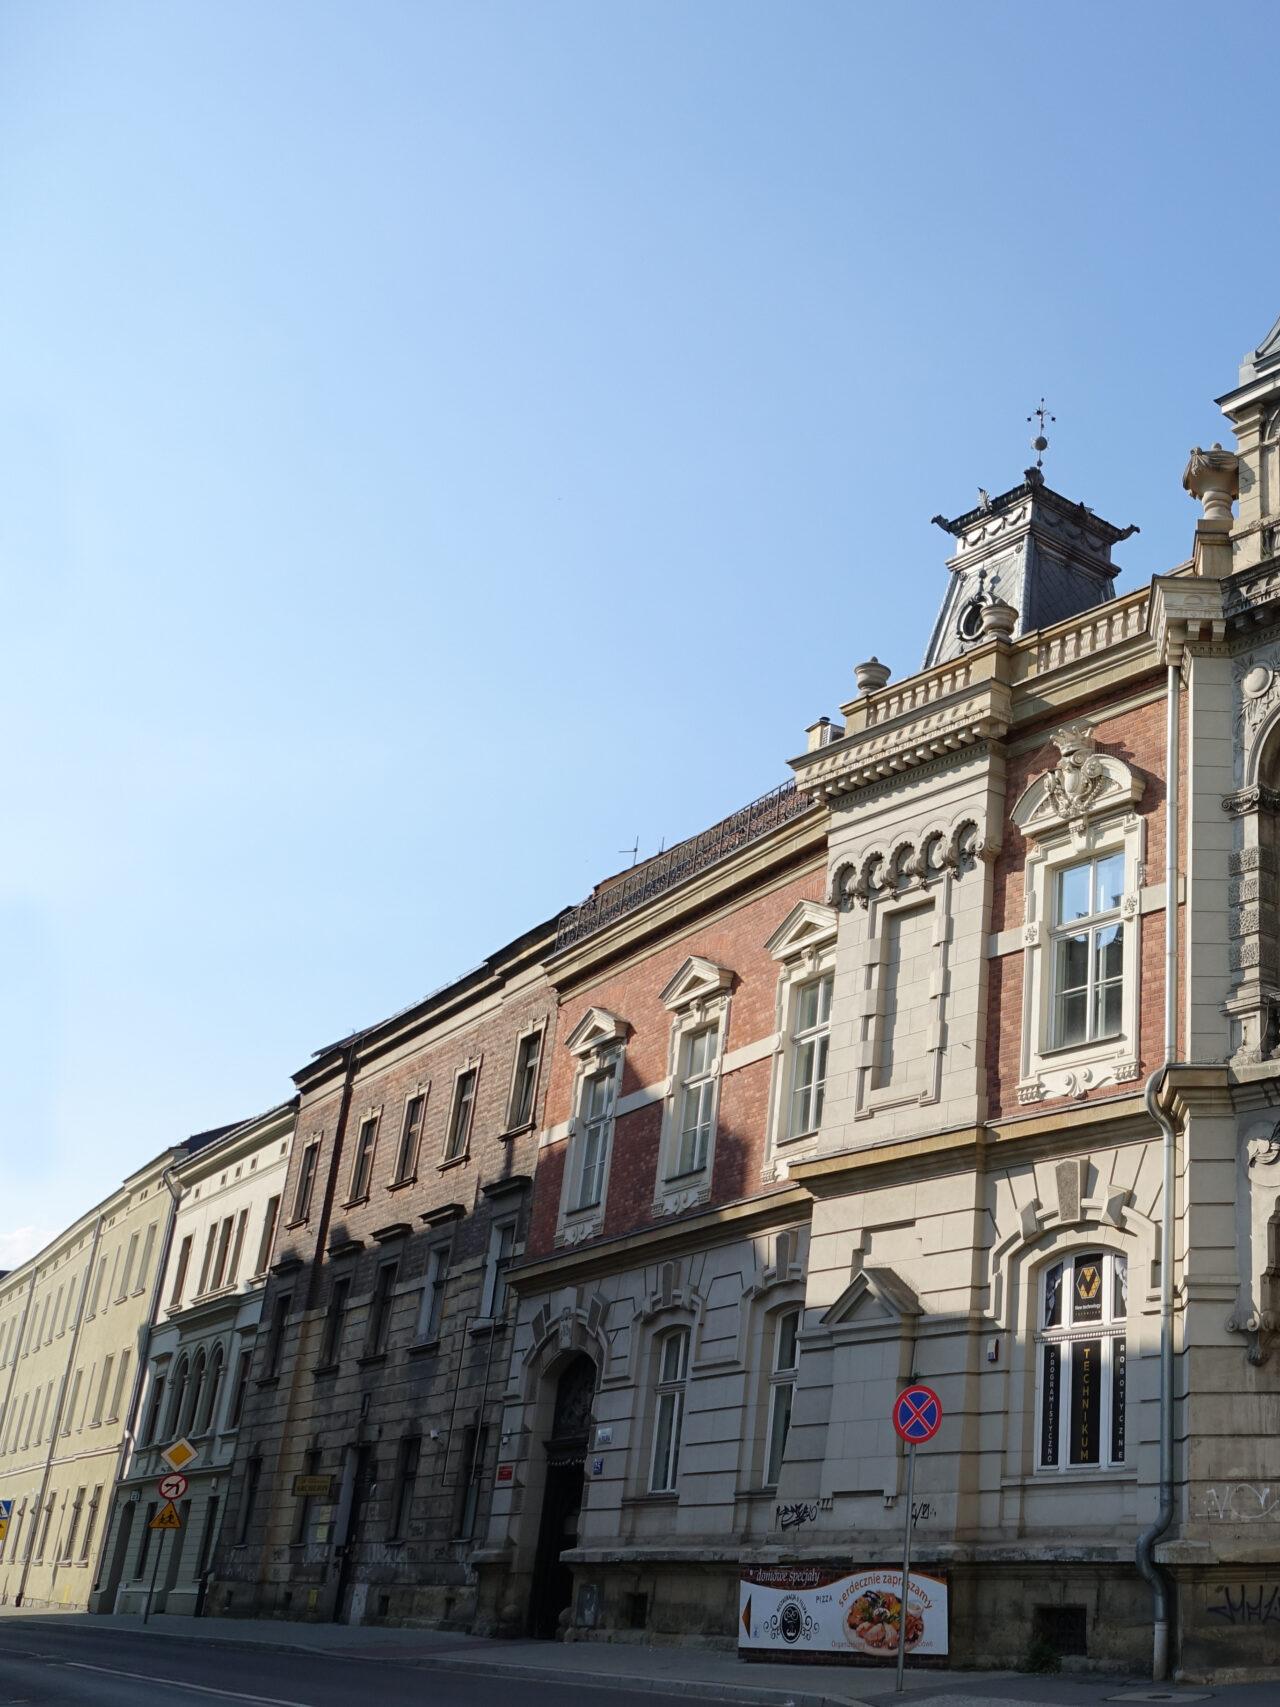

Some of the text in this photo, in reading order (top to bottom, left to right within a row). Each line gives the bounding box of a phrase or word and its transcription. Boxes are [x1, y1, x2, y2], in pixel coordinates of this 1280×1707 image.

[1081, 1348, 1091, 1460] TECHNIKUM
[815, 1594, 833, 1604] PIZZA
[838, 1574, 933, 1609] serdecznie zaprszamy
